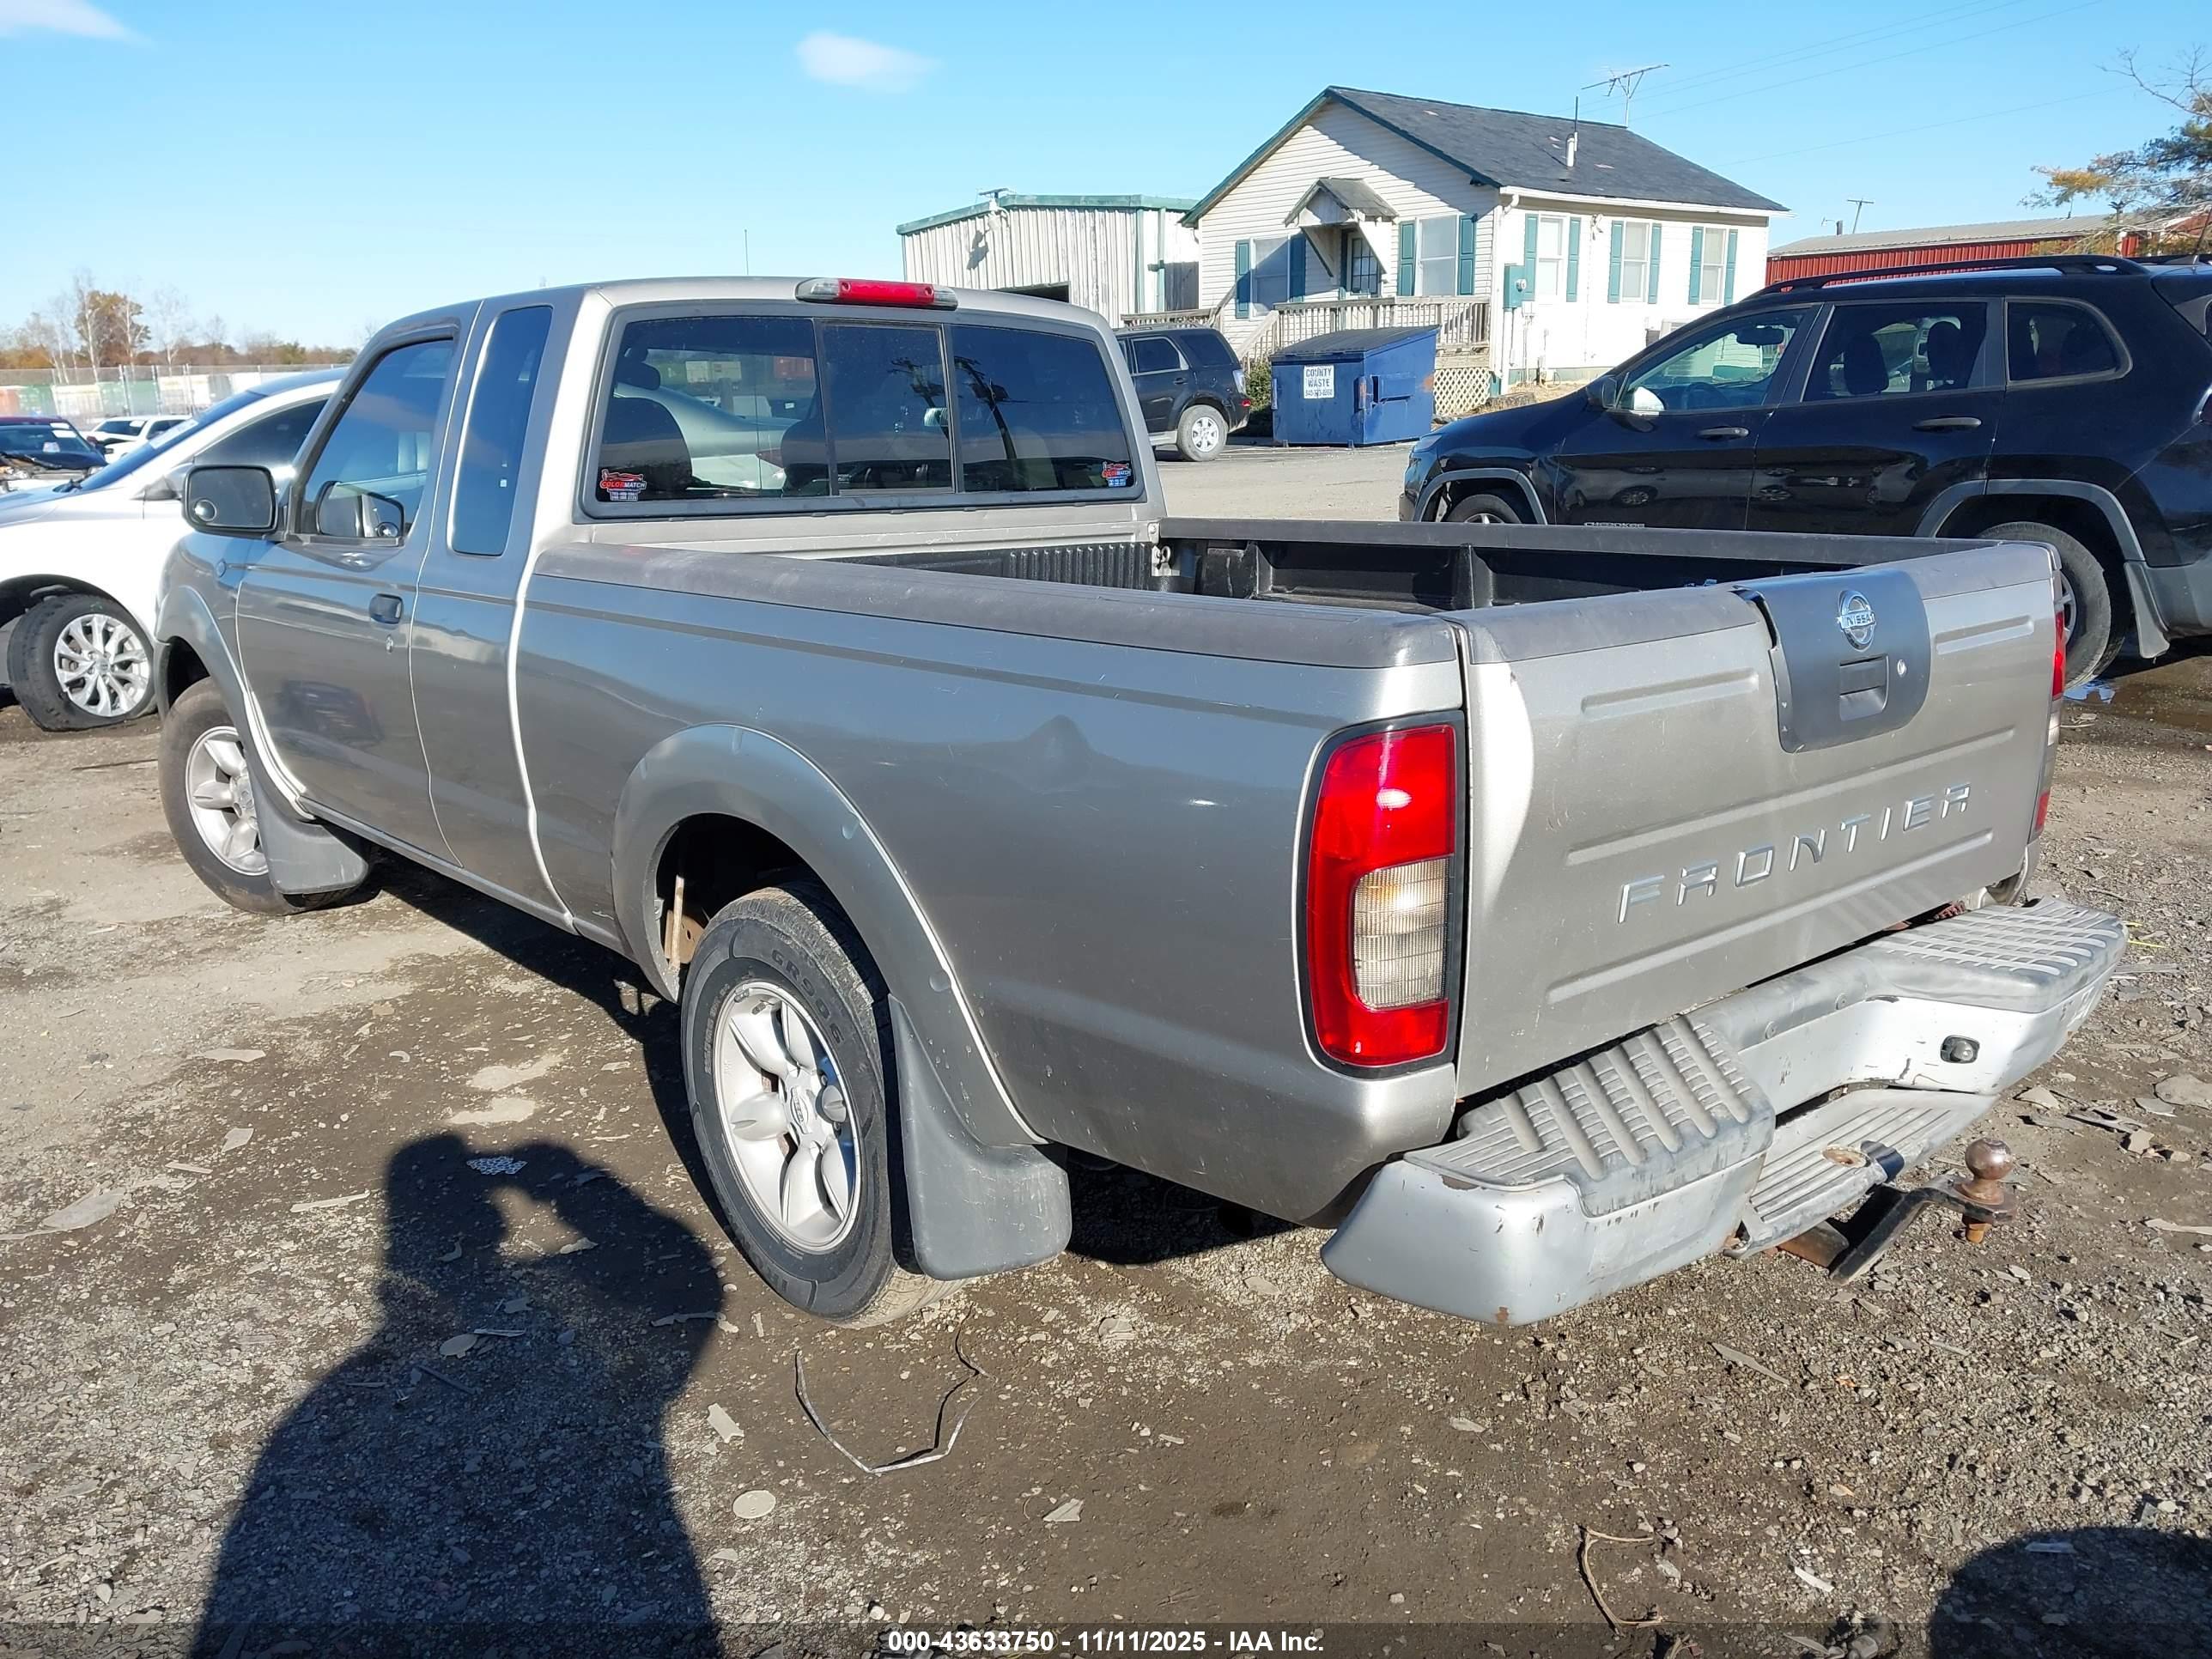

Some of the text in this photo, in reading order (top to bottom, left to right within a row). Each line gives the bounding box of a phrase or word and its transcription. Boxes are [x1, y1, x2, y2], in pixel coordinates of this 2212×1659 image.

[1306, 368, 1331, 377] COUNTY
[1308, 378, 1330, 387] WASTE
[1618, 782, 1972, 923] FRONTIER
